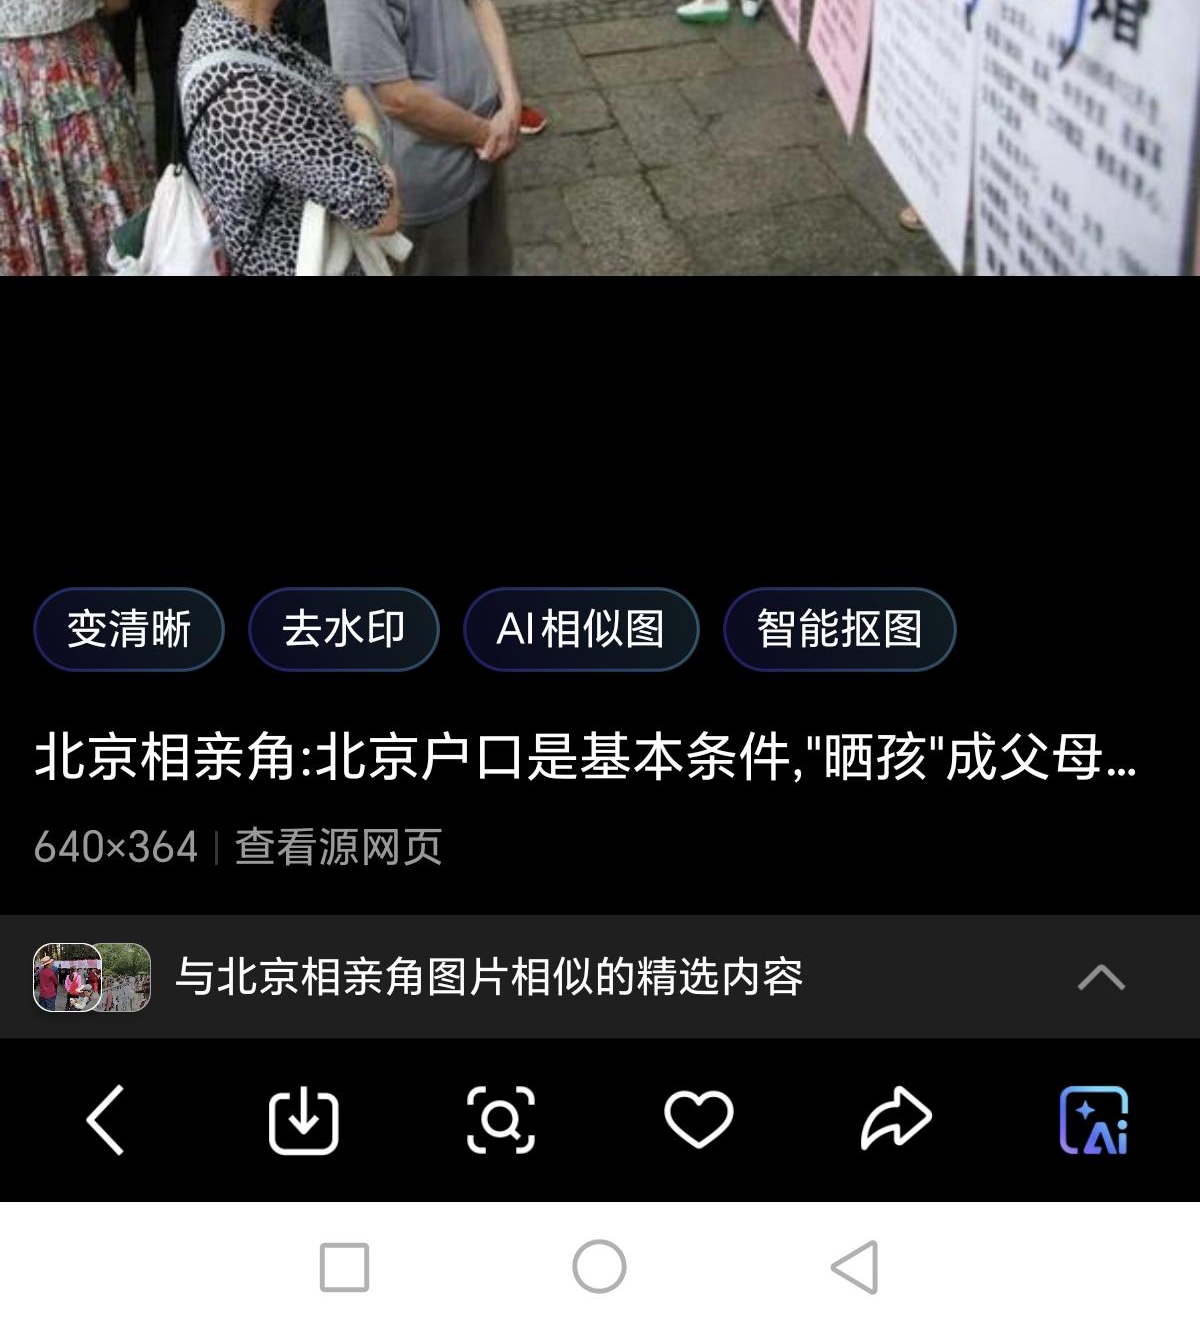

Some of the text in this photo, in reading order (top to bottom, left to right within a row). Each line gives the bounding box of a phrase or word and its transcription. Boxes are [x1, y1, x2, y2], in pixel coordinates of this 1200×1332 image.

[67, 607, 191, 649] 变清晰
[282, 607, 404, 649] 去水印
[496, 607, 663, 649] AI相似图
[757, 607, 921, 649] 智能抠图
[235, 825, 443, 867] 查看源网页
[175, 955, 803, 997] 与北京相亲角图片相似的精选内容
